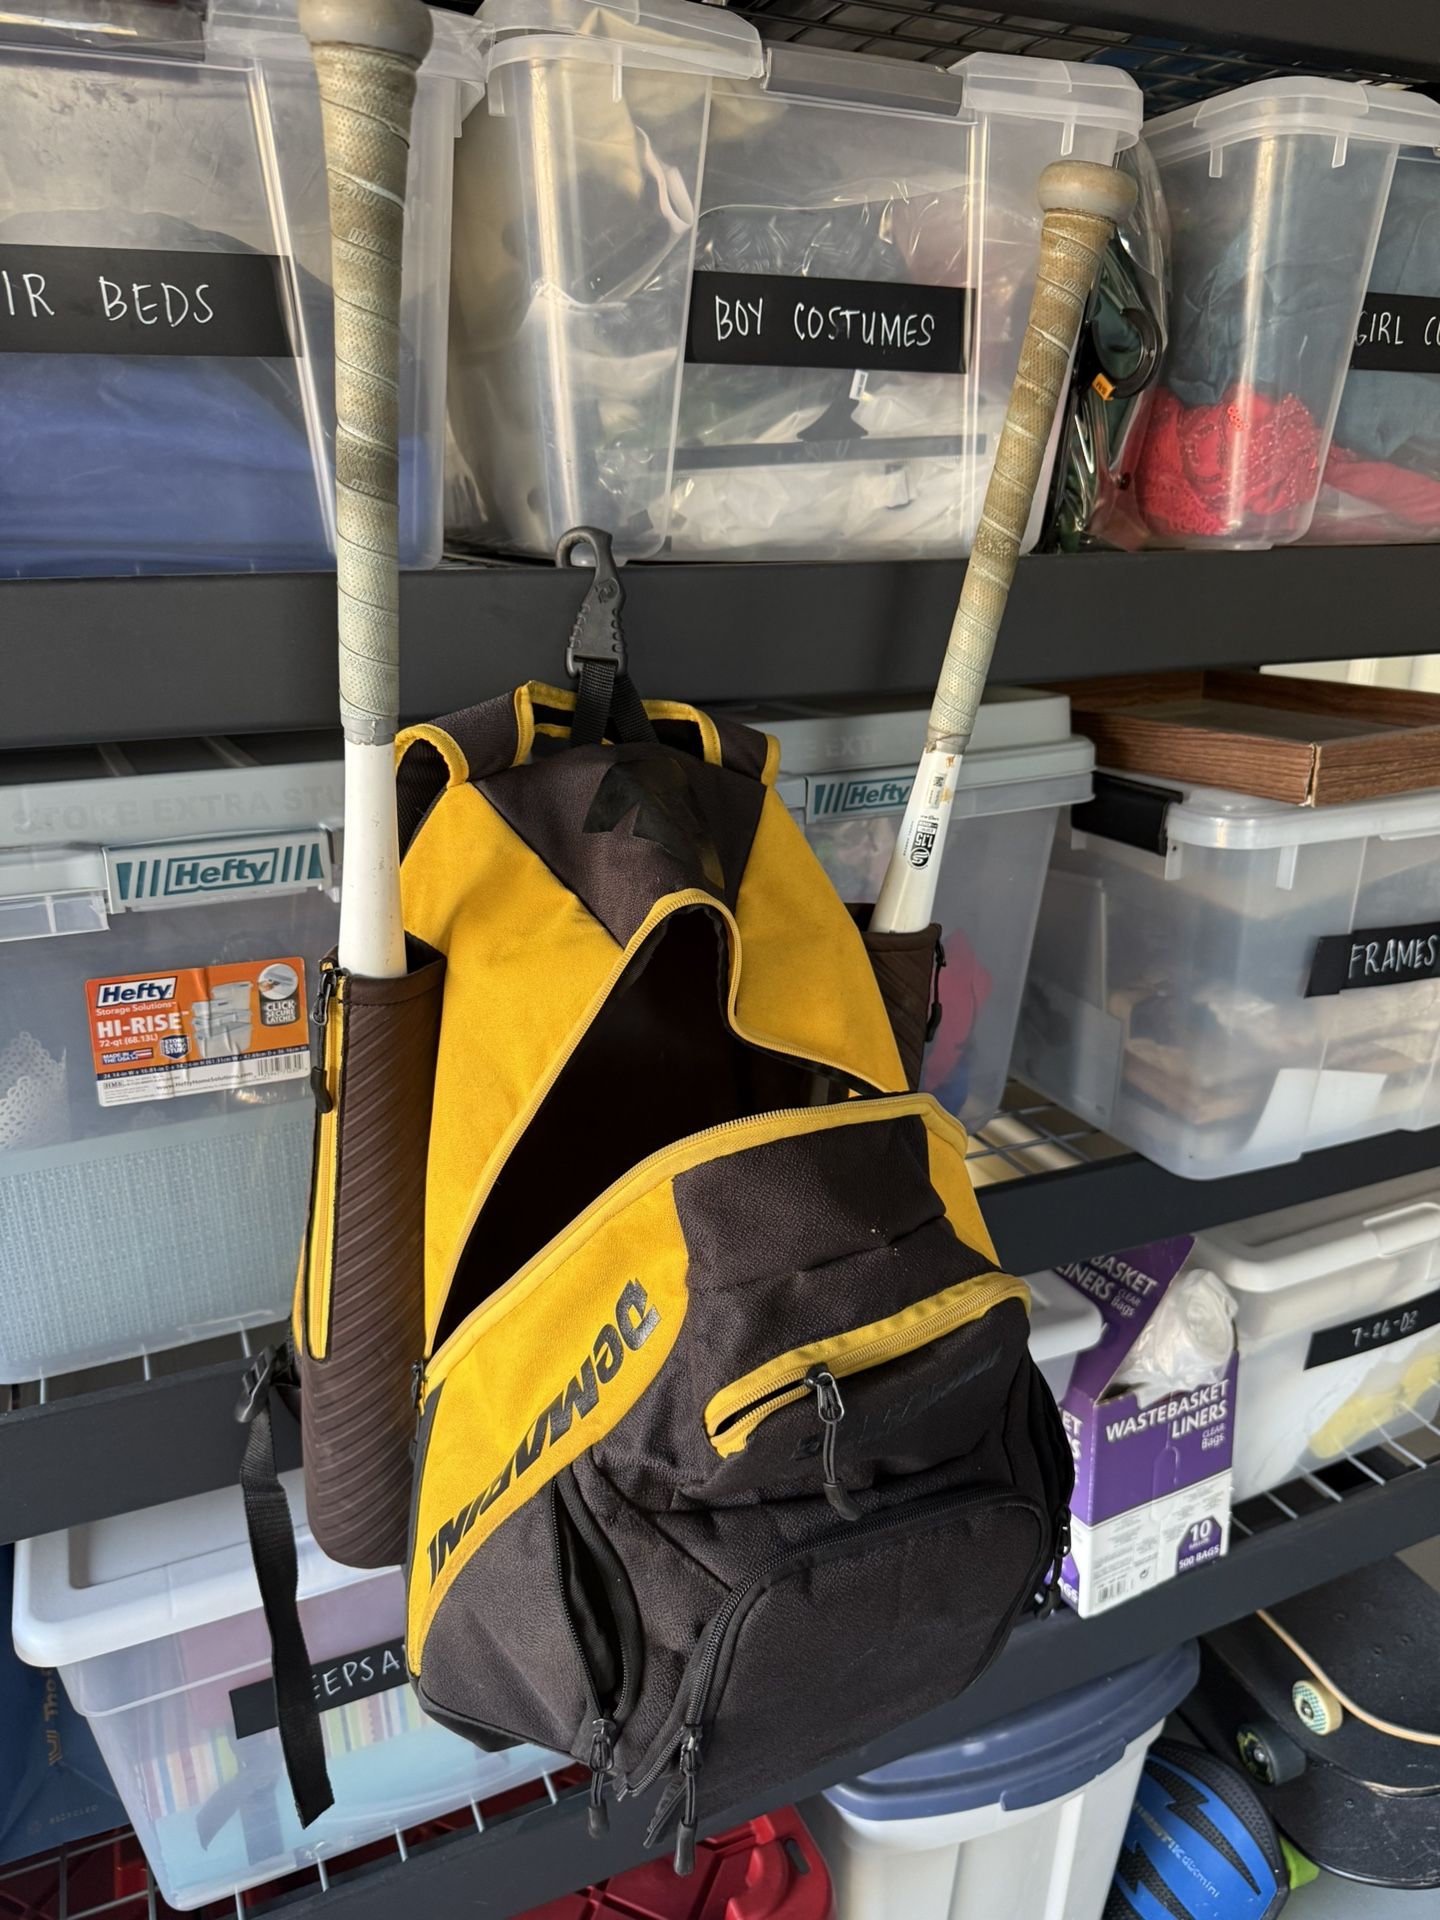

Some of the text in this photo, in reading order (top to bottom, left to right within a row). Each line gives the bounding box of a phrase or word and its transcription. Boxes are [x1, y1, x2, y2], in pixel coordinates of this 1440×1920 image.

[2, 270, 214, 327] IR BEDS
[715, 295, 935, 348] BOY COSTUMES
[851, 783, 910, 805] Hefty
[175, 858, 269, 886] Hefty
[1348, 934, 1437, 979] FRAMES
[102, 983, 172, 1003] Hefty
[96, 1002, 172, 1016] Storage Solutions
[266, 999, 295, 1011] CLICK
[266, 1008, 294, 1017] SECURE
[97, 1012, 182, 1039] HI-RISE
[1106, 1379, 1229, 1442] WASTEBASKET
[1172, 1400, 1228, 1439] LINERS
[1201, 1433, 1225, 1450] Bags
[1202, 1423, 1226, 1439] CLEAR
[1190, 1520, 1212, 1541] 10
[1179, 1555, 1195, 1569] 500
[1196, 1544, 1220, 1562] BAGS
